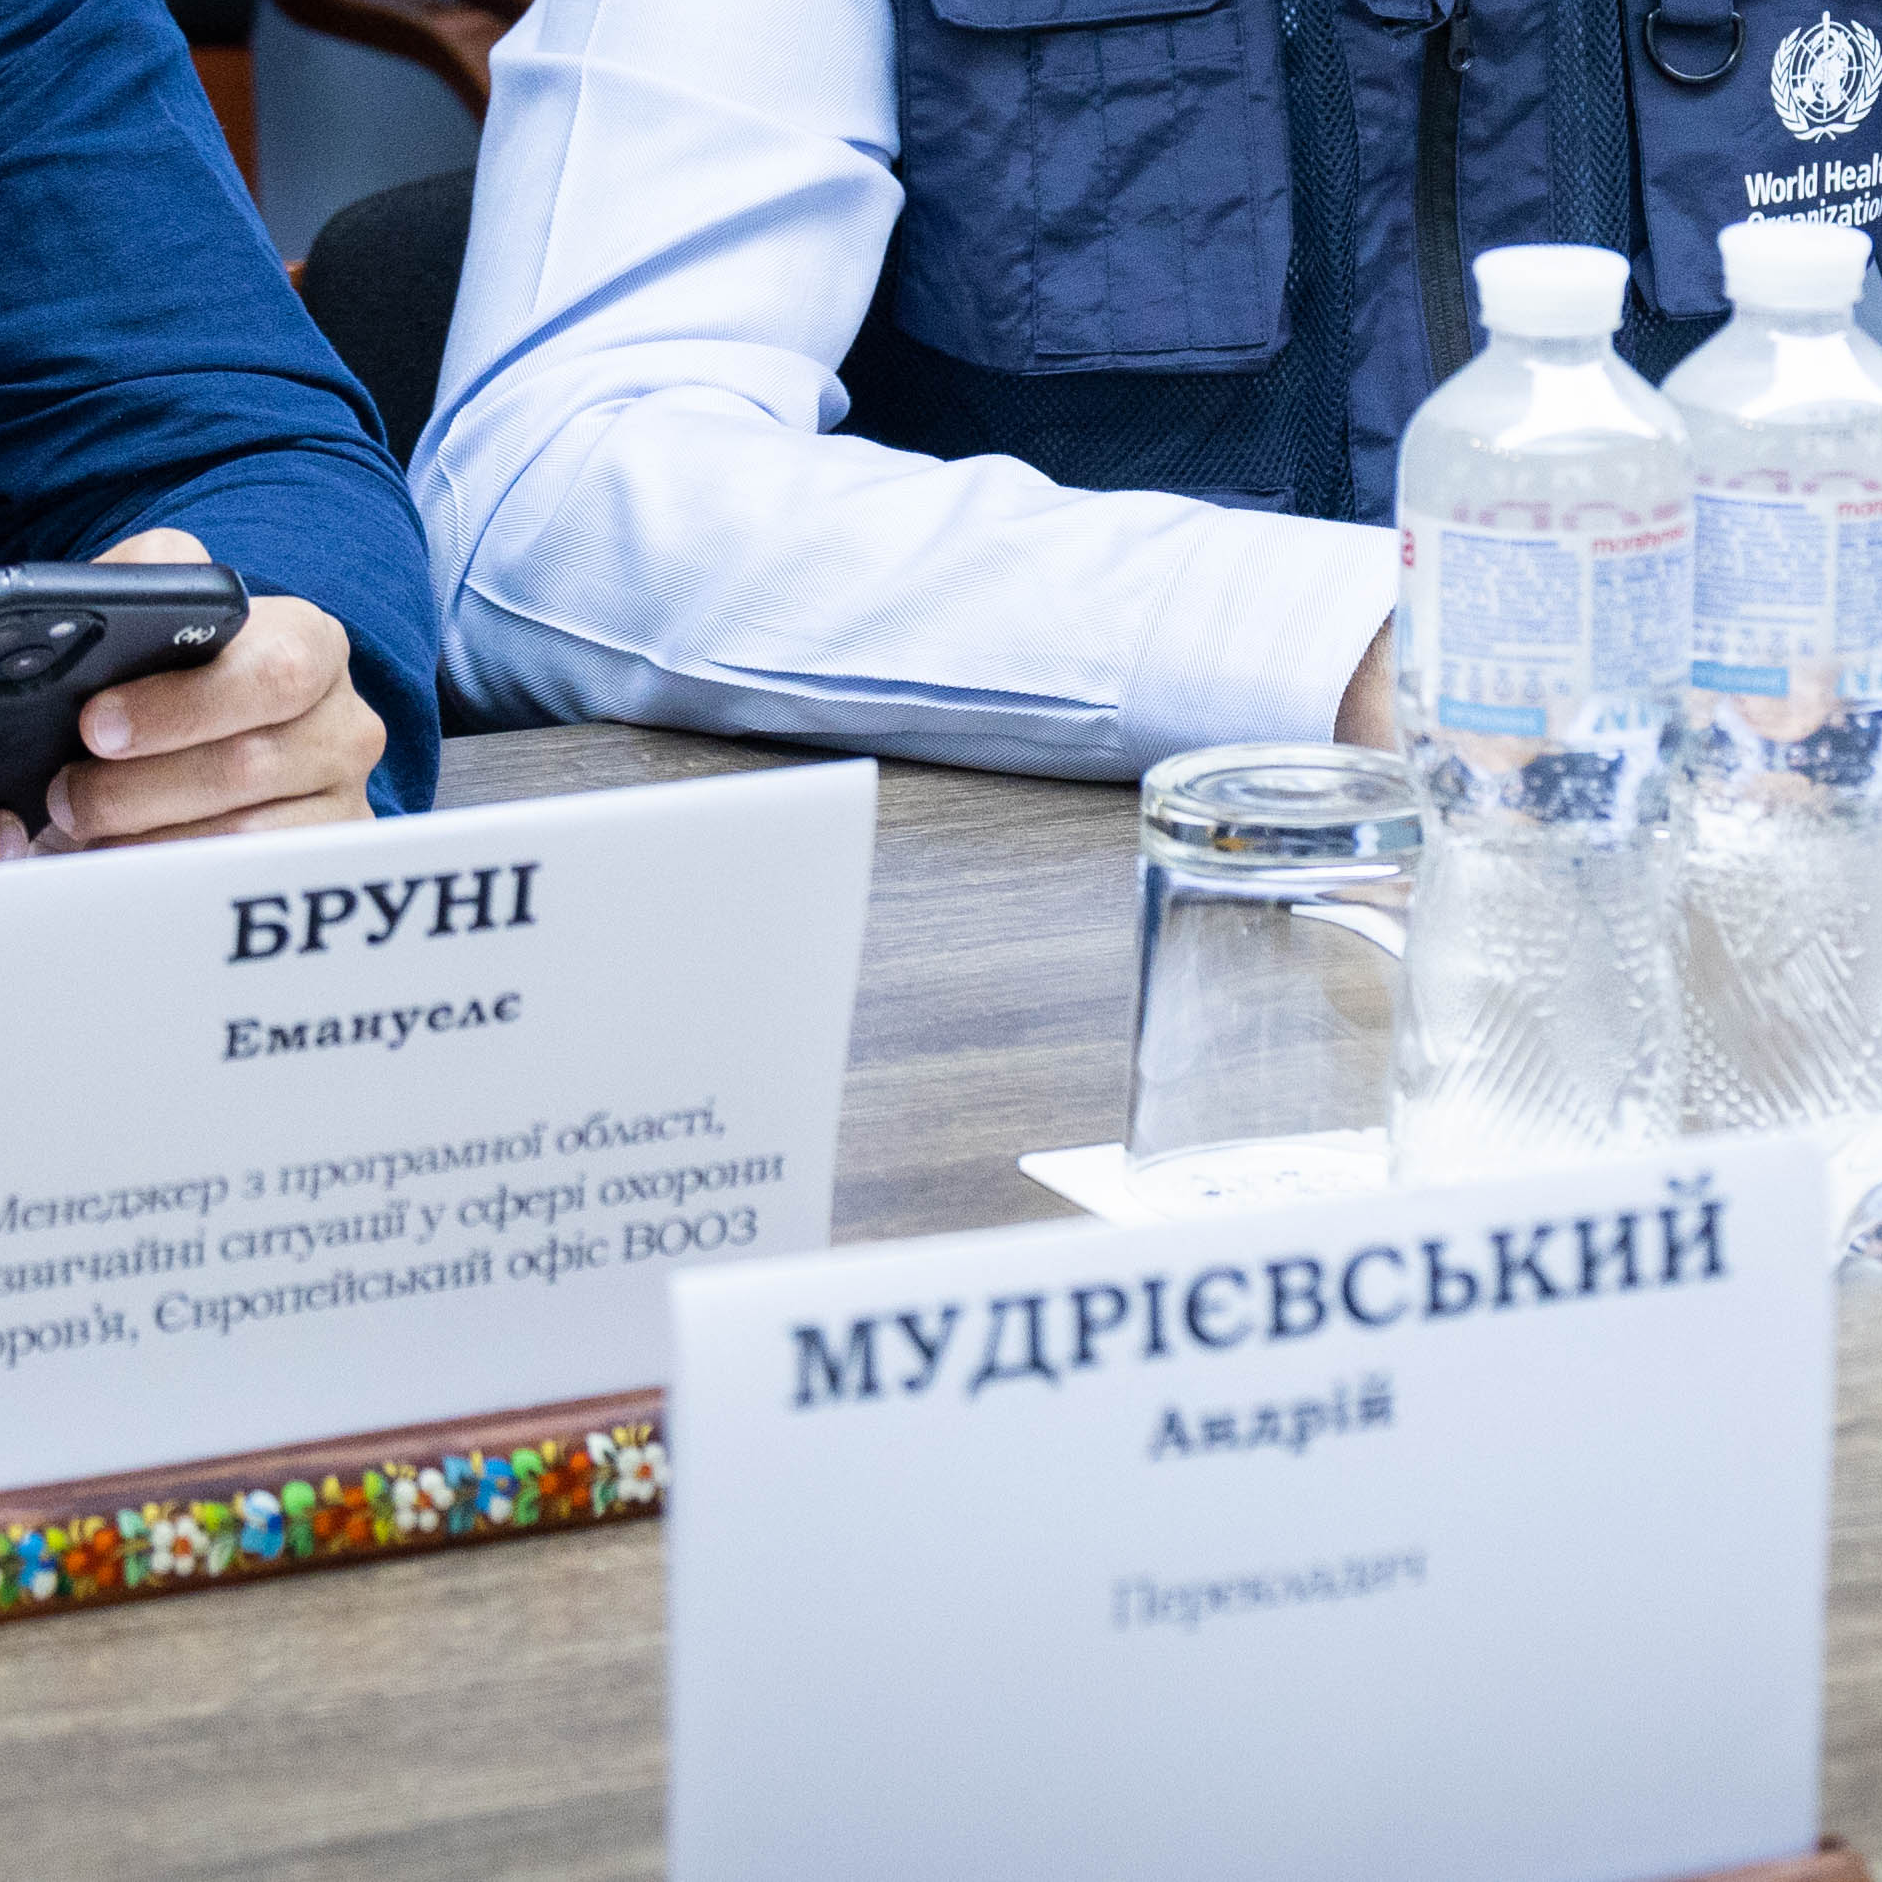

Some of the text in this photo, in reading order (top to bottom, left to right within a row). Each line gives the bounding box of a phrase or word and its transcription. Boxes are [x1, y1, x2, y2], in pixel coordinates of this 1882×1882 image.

[1744, 162, 1818, 207] World
[225, 859, 543, 965] БРУНІ
[239, 1166, 267, 1201] з
[276, 1118, 550, 1204] програмної
[554, 1093, 727, 1158] області,
[218, 1197, 410, 1265] ситуації
[413, 1202, 446, 1246] у
[456, 1172, 589, 1233] сфері
[597, 1152, 787, 1208] охорони
[152, 1246, 493, 1337] Європейський
[505, 1229, 611, 1287] офіс
[620, 1204, 760, 1264] ВООЗ
[785, 1170, 1734, 1414] МУДРІЄВСЬКИЙ
[1144, 1370, 1397, 1462] Андрій
